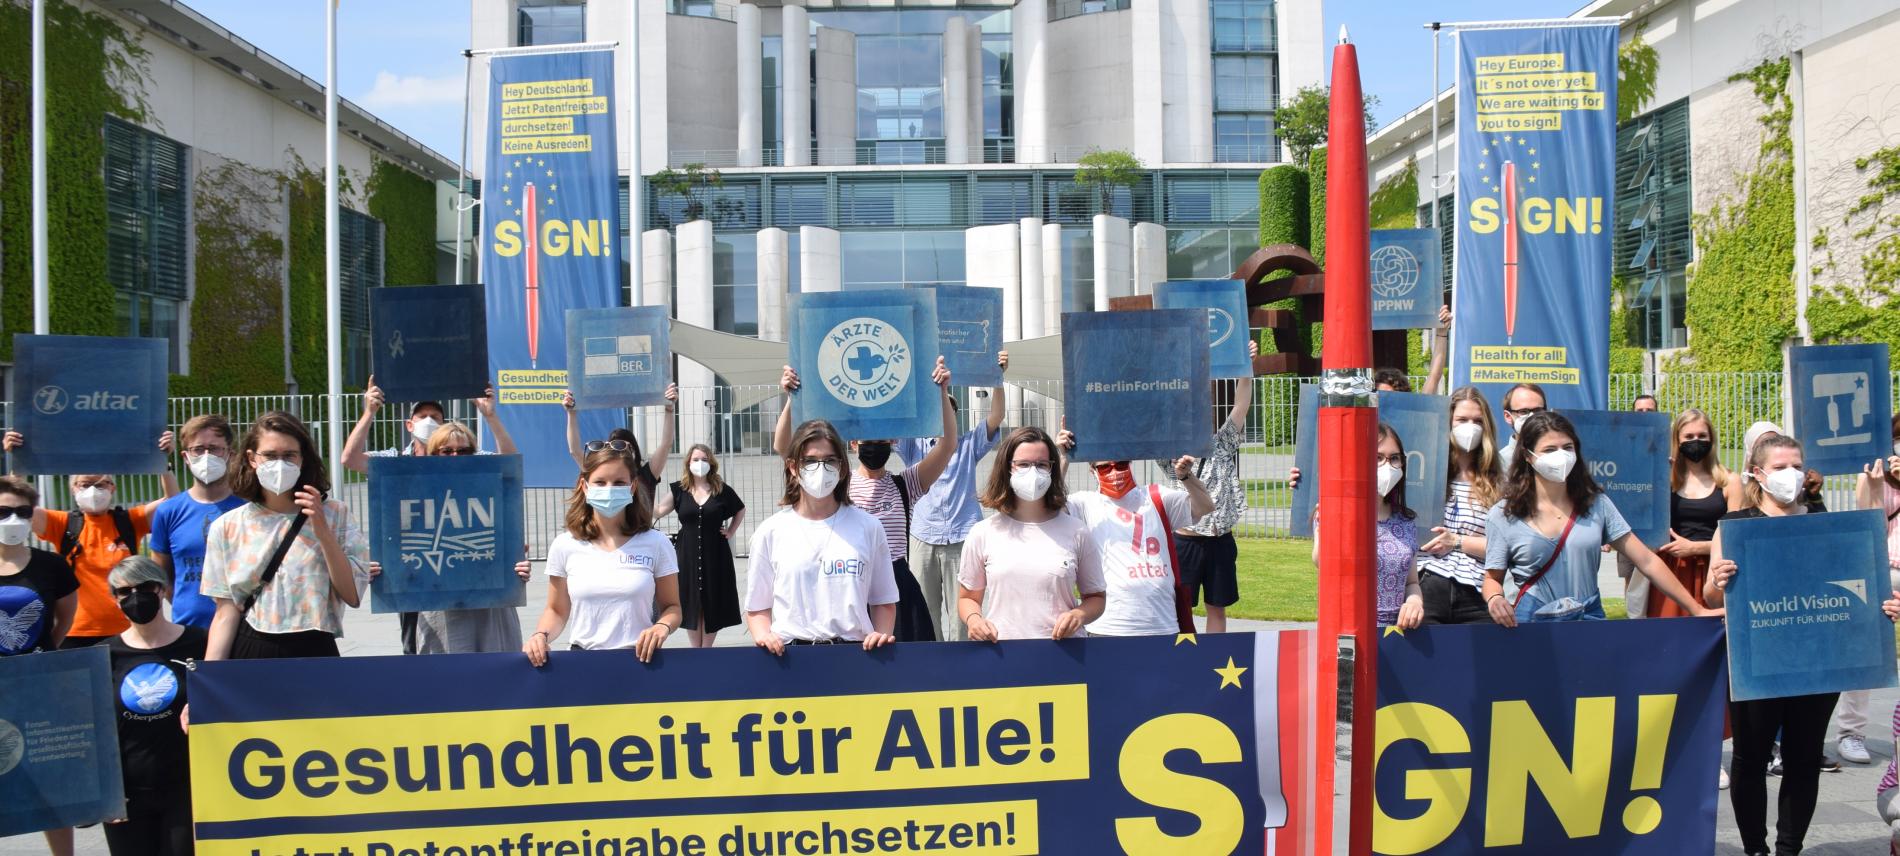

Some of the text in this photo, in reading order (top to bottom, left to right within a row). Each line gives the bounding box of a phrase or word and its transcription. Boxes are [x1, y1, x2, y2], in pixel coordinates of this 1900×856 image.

[1479, 58, 1560, 72] Hey Europe.
[1506, 80, 1528, 89] not
[1532, 79, 1561, 88] over
[1565, 76, 1589, 88] yet.
[505, 83, 591, 98] Hey Deutschland.
[505, 101, 604, 115] Jetzt Patentfreigabe
[1480, 95, 1601, 109] We are waiting for
[505, 121, 571, 133] durchsetzen!
[1481, 116, 1557, 130] you to sign!
[504, 138, 588, 151] Keine Ausreden!
[1373, 299, 1414, 311] IPPNW
[832, 323, 883, 348] ÄRZTE
[1474, 349, 1563, 361] Health for all!
[621, 361, 643, 372] BER
[501, 373, 568, 383] Gesundheit
[1473, 369, 1576, 382] #MakeThemSign
[829, 372, 901, 401] DER WELT
[1085, 379, 1190, 393] #BerlinForIndia
[74, 391, 139, 410] attac
[502, 391, 565, 401] #GebtDiePa
[1607, 480, 1653, 492] Kampagne
[400, 490, 495, 531] FIAN
[1128, 562, 1169, 579] attac
[1750, 595, 1849, 614] World Vision
[1752, 612, 1850, 628] ZUKUNFT FÜR KINDER
[123, 710, 173, 722] Cyberpeace
[228, 702, 1057, 799] Gesundheit für Alle!
[718, 812, 1016, 856] durchsetzen!
